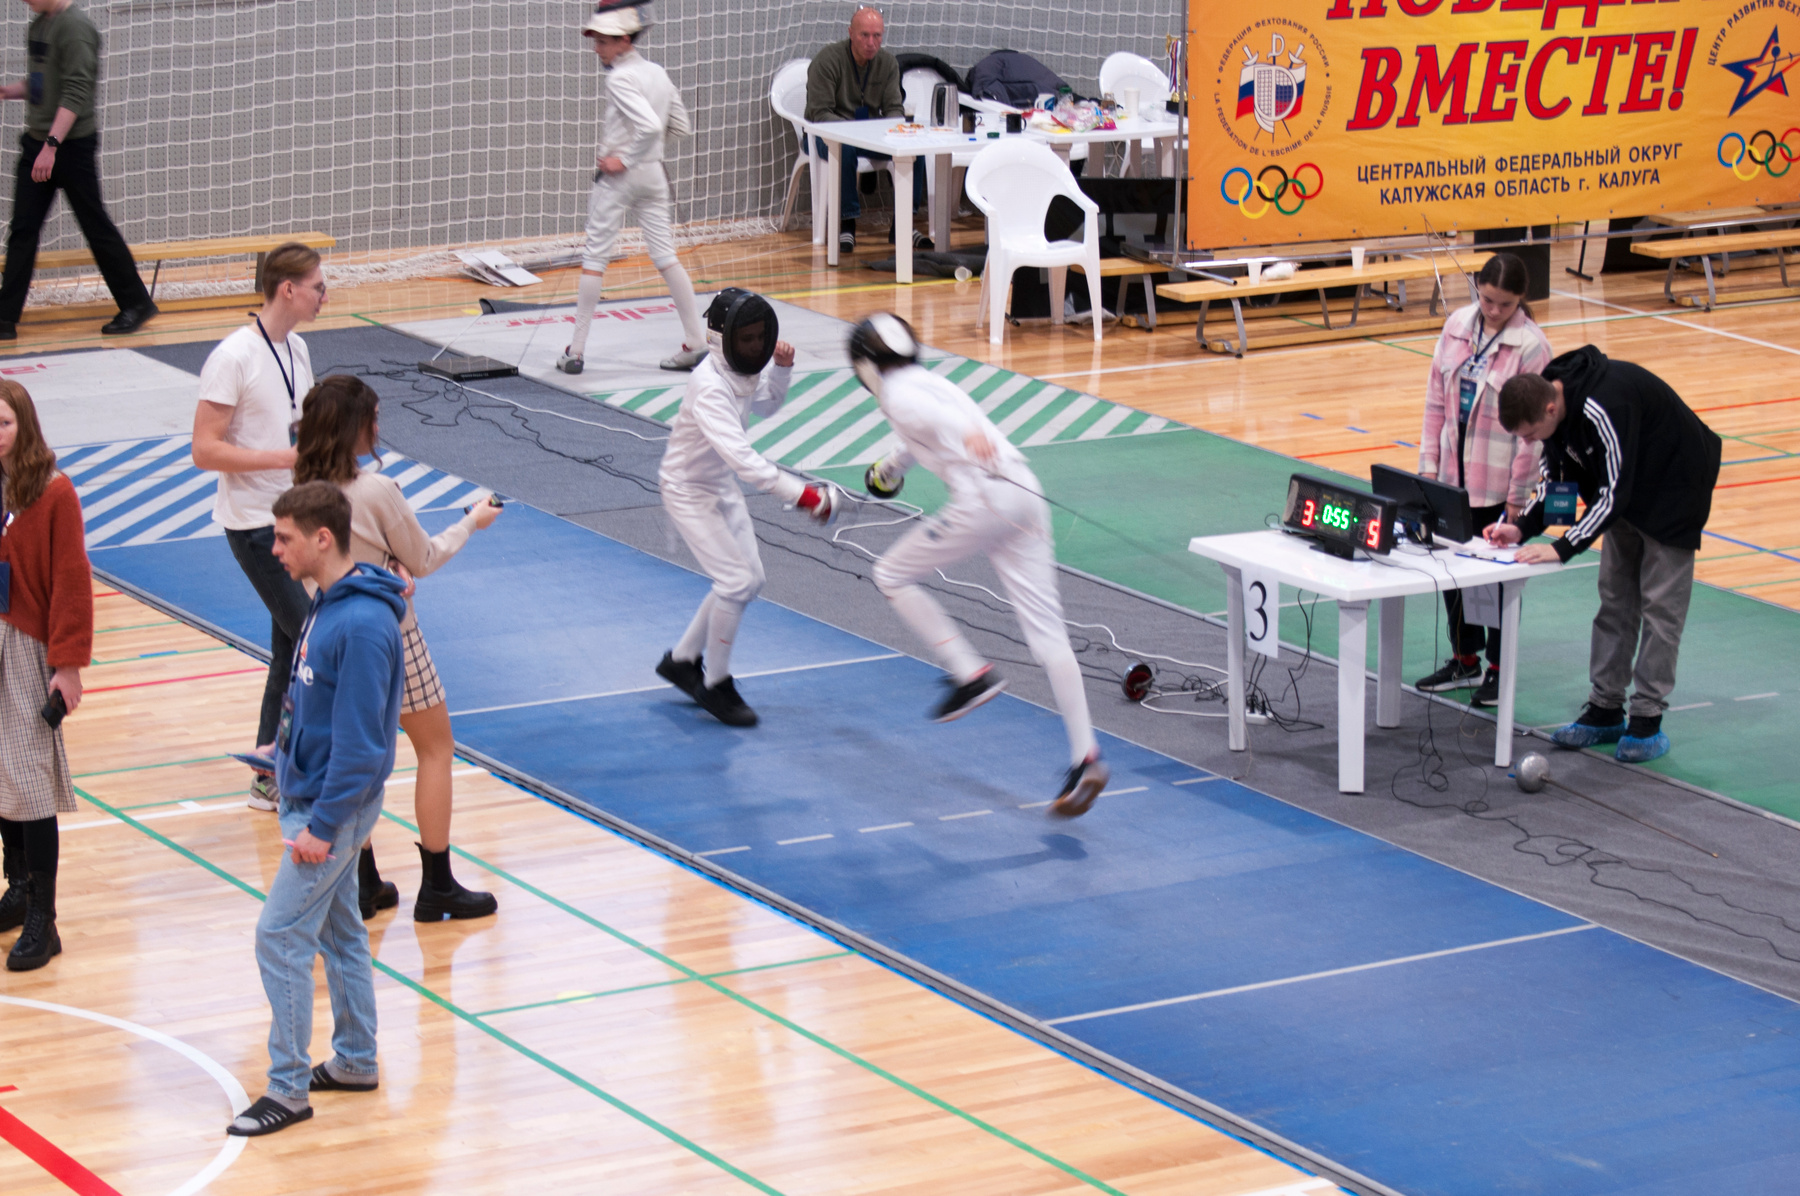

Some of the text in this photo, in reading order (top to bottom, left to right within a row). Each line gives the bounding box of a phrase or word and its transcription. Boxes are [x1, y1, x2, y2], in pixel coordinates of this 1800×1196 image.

[1218, 18, 1330, 73] ФЕДЕРАЦИЯ ФЕХТОВАНИЯ РОССИИ
[1707, 28, 1726, 66] ЦЕНТР
[1727, 0, 1774, 29] РАЗВИТИЯ
[1345, 27, 1699, 131] ВМЕСТЕ!
[1217, 107, 1248, 150] FEDERATION
[1250, 147, 1259, 156] DE
[1304, 131, 1314, 142] DE
[1314, 119, 1322, 130] LA
[1320, 85, 1332, 117] RUSSIE
[1357, 143, 1683, 185] ЦЕНТРАЛЬНЫЙ ФЕДЕРАЛЬНЫЙ ОКРУГ
[1380, 169, 1661, 205] КАЛУЖСКАЯ ОБЛАСТЬ г. КАЛУГА
[1302, 500, 1315, 526] 3
[1367, 519, 1380, 547] 5
[1249, 581, 1268, 641] 3
